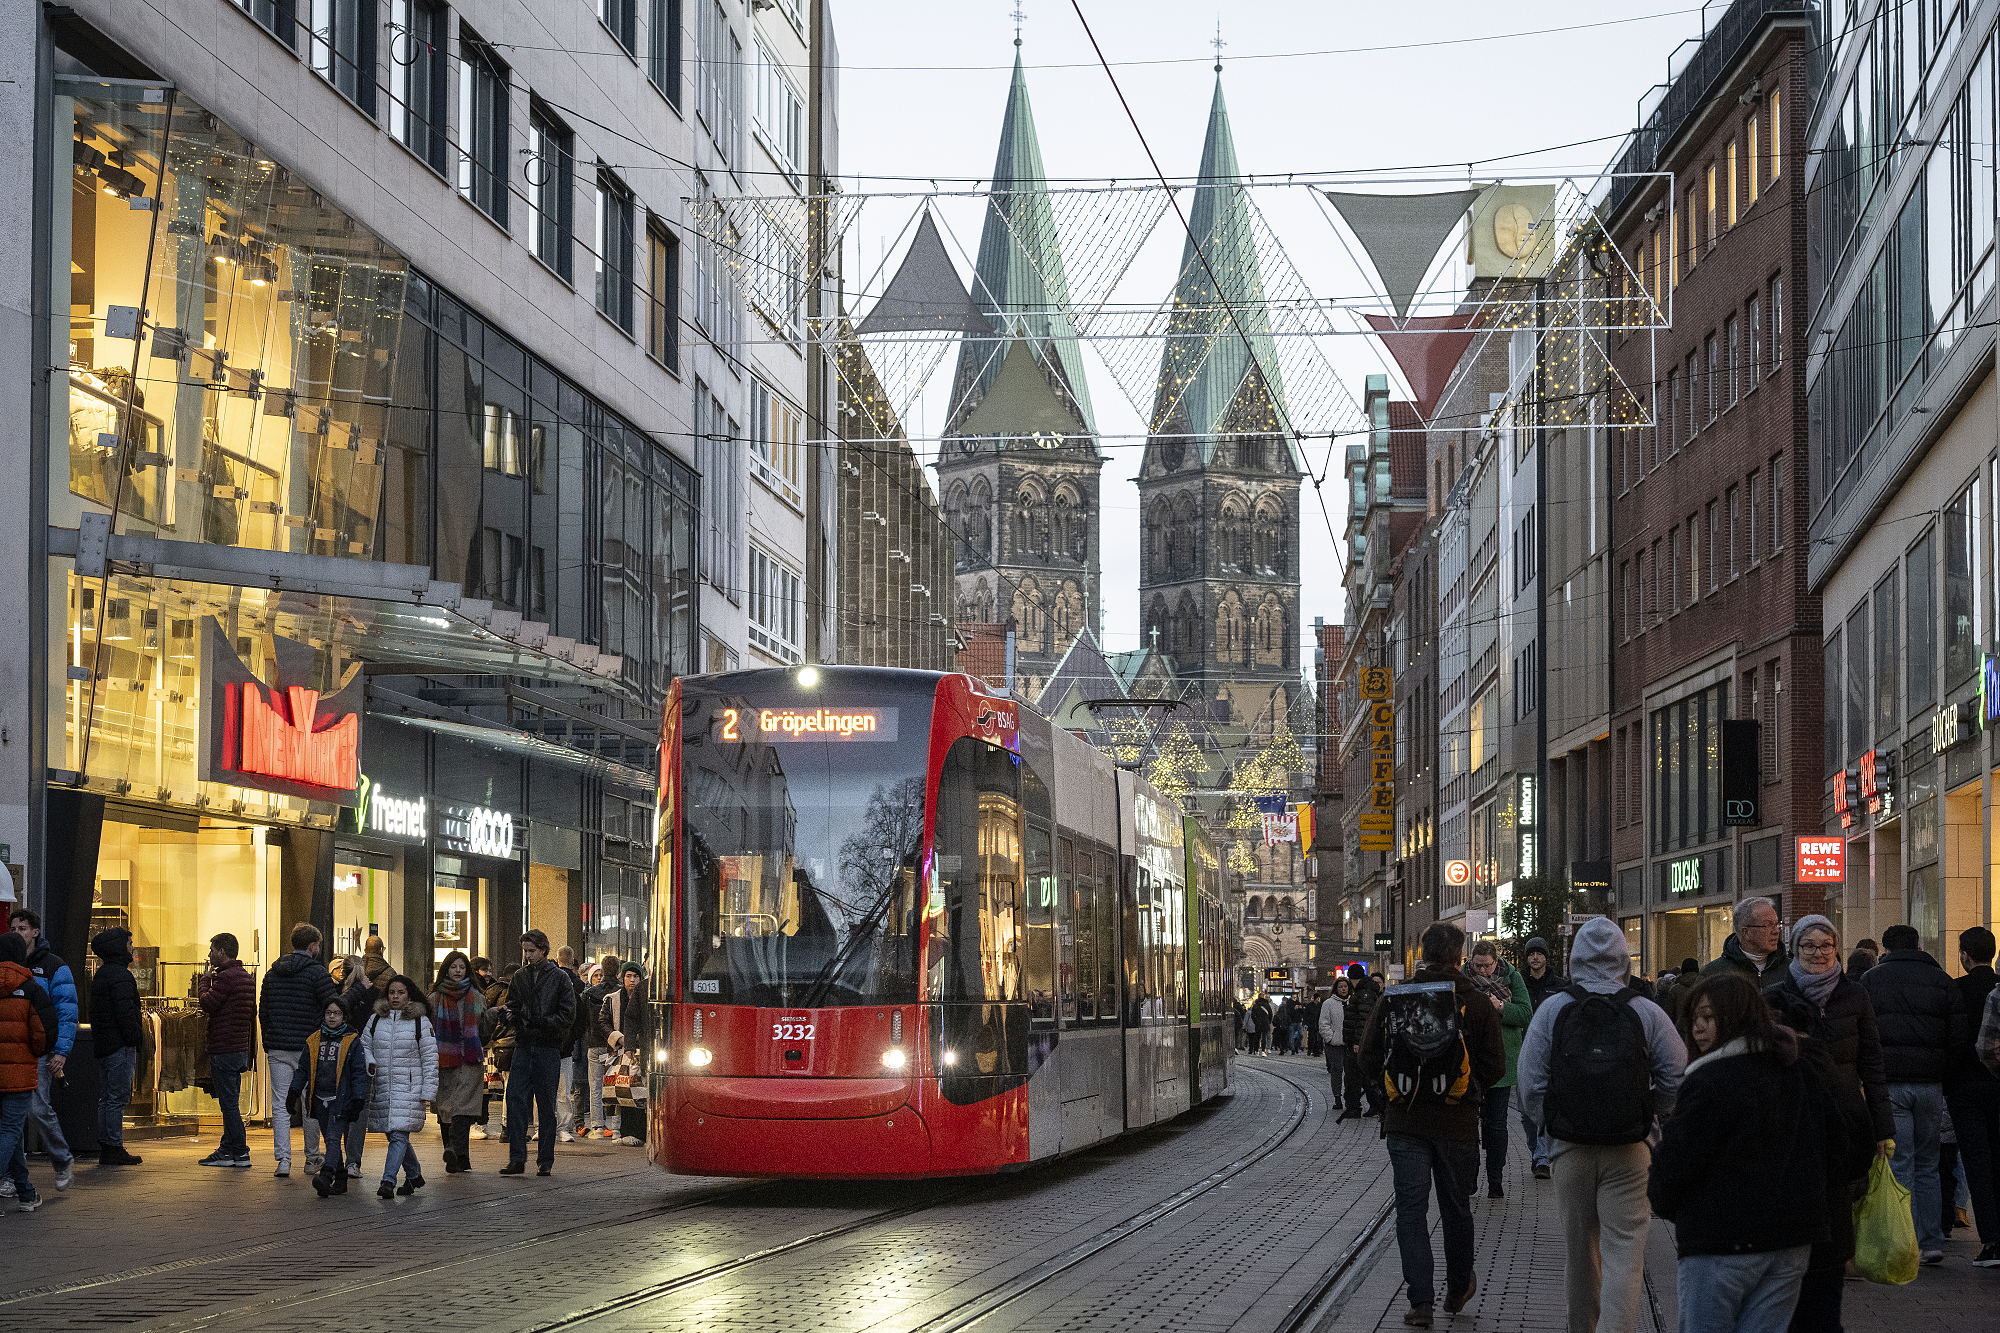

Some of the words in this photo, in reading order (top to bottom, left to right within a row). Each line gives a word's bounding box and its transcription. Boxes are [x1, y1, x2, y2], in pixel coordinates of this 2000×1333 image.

[722, 708, 738, 740] 2
[760, 709, 876, 737] Gröpelingen
[997, 711, 1015, 730] BSAG
[1933, 703, 1958, 754] BÜCHER
[372, 783, 426, 838] freenet
[470, 806, 513, 859] ecco
[1800, 842, 1841, 855] REWE
[1803, 857, 1818, 866] Mo.
[1825, 857, 1839, 866] Sa.
[1671, 857, 1699, 893] DOUGLAS
[1800, 868, 1807, 877] 7
[1814, 868, 1825, 877] 21
[1826, 868, 1841, 877] Uhr
[697, 982, 717, 992] 5013
[772, 1024, 816, 1041] 3232
